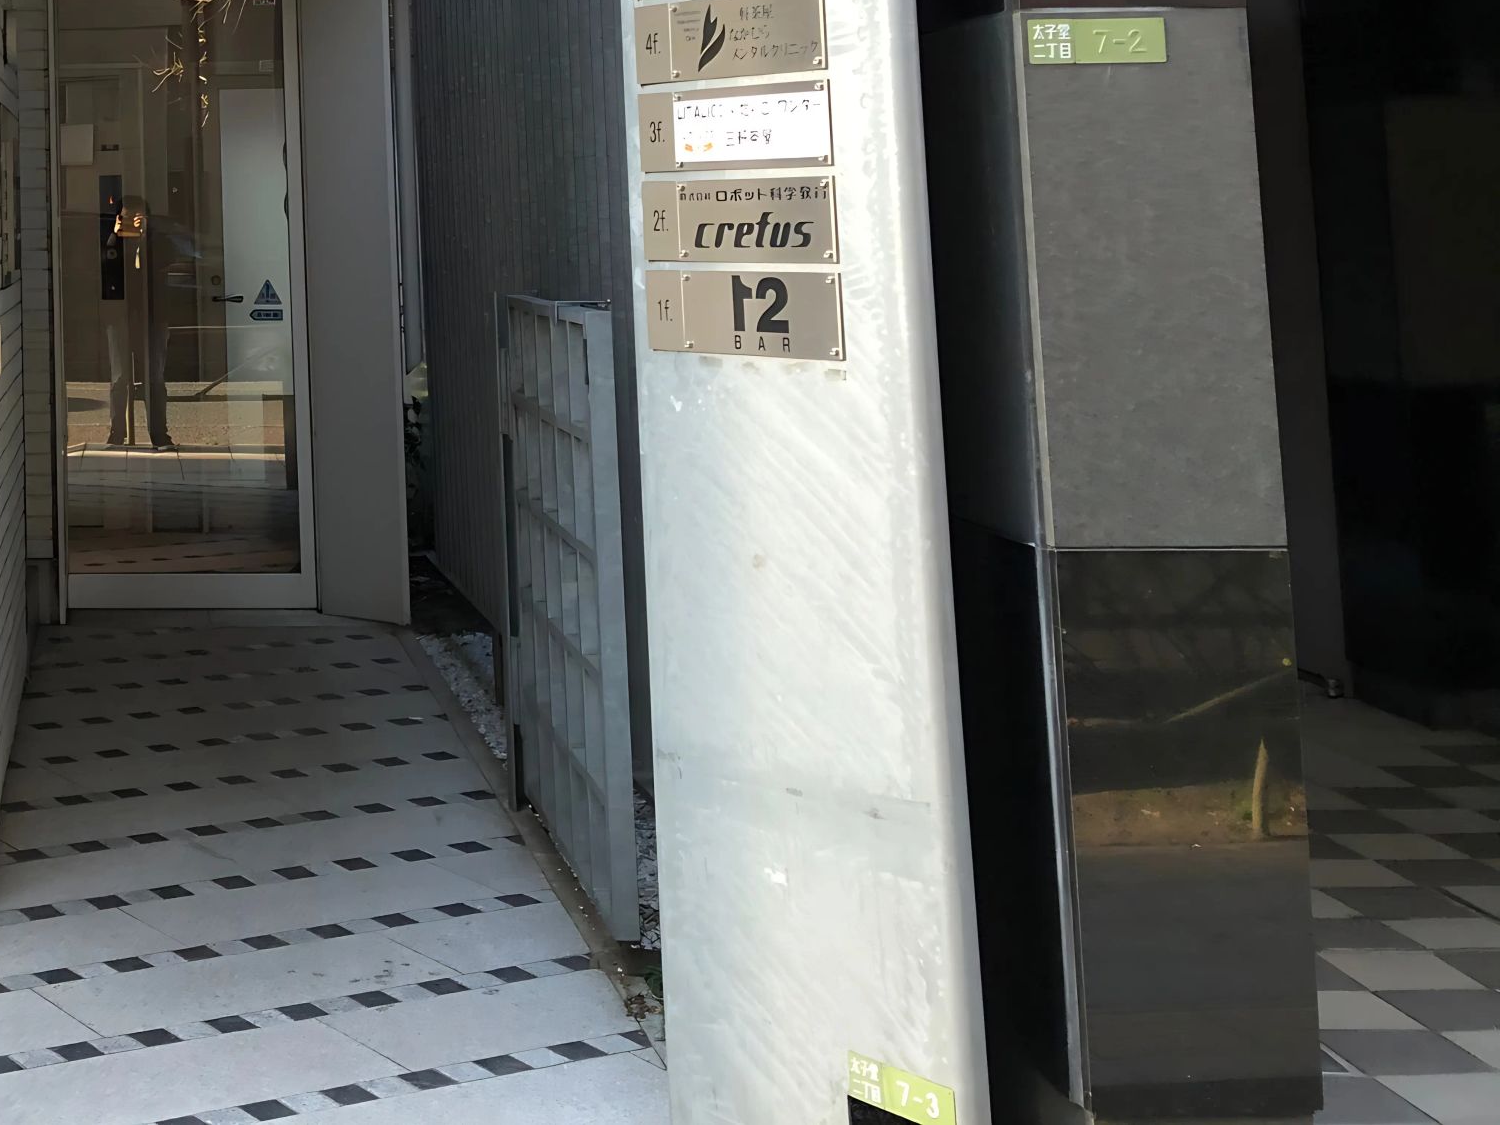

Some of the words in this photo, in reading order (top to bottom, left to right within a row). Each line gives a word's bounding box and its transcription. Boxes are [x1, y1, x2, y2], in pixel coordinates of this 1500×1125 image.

[1033, 42, 1072, 59] 二丁目
[1092, 28, 1148, 54] 7-2
[734, 335, 791, 352] BAR
[895, 1080, 940, 1119] 7-3
